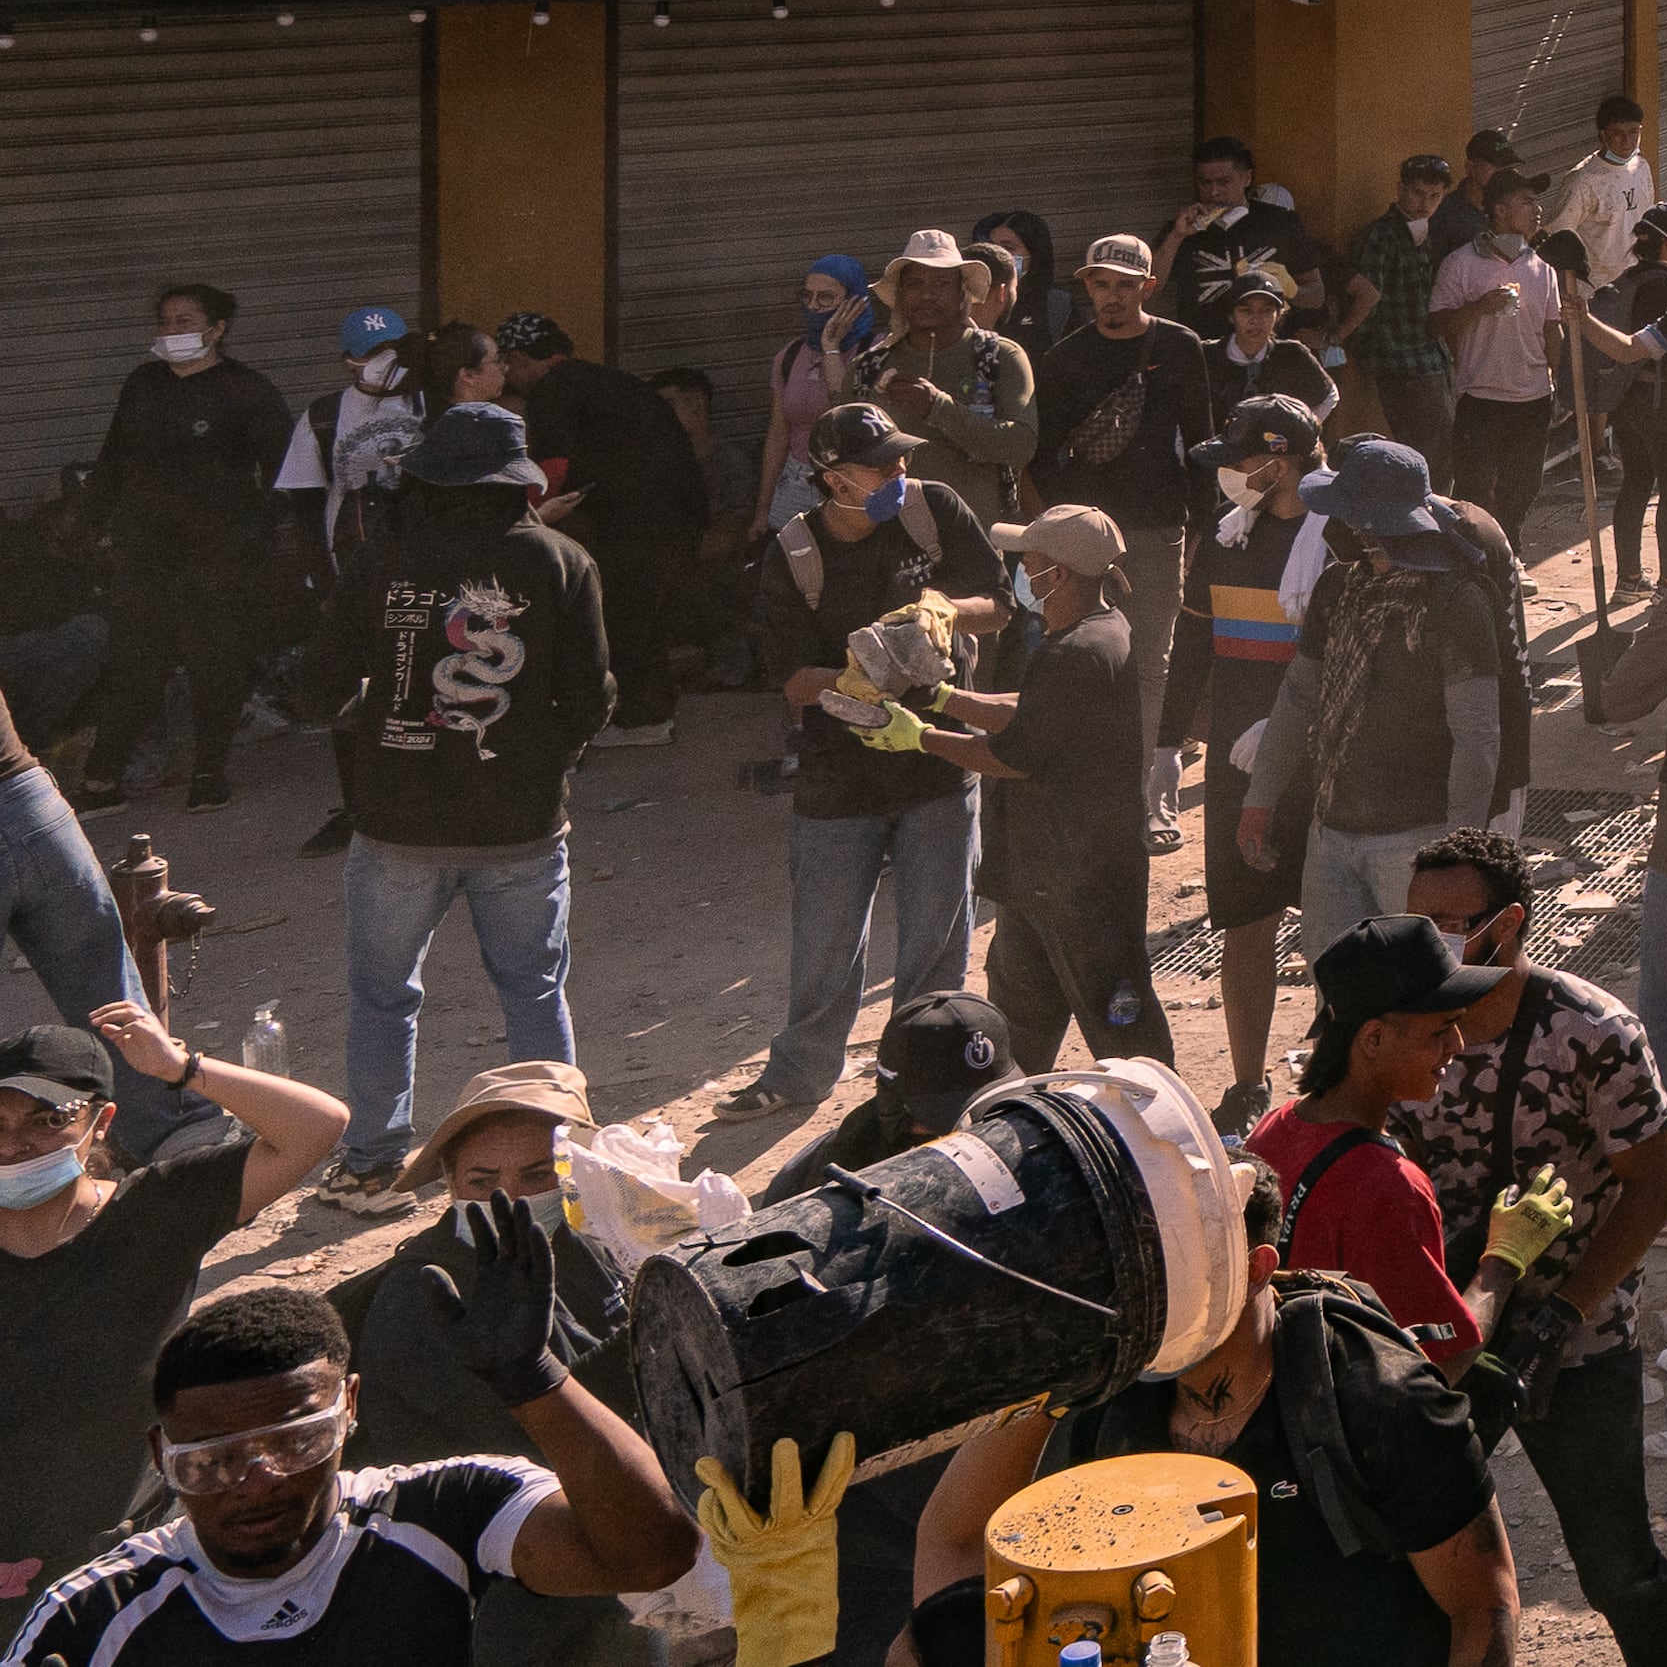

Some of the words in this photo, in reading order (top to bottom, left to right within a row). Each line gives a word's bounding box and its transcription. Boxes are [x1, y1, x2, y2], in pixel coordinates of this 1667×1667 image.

[363, 313, 387, 332] NY
[386, 590, 456, 607] ドラゴン
[260, 1608, 309, 1631] adidas
